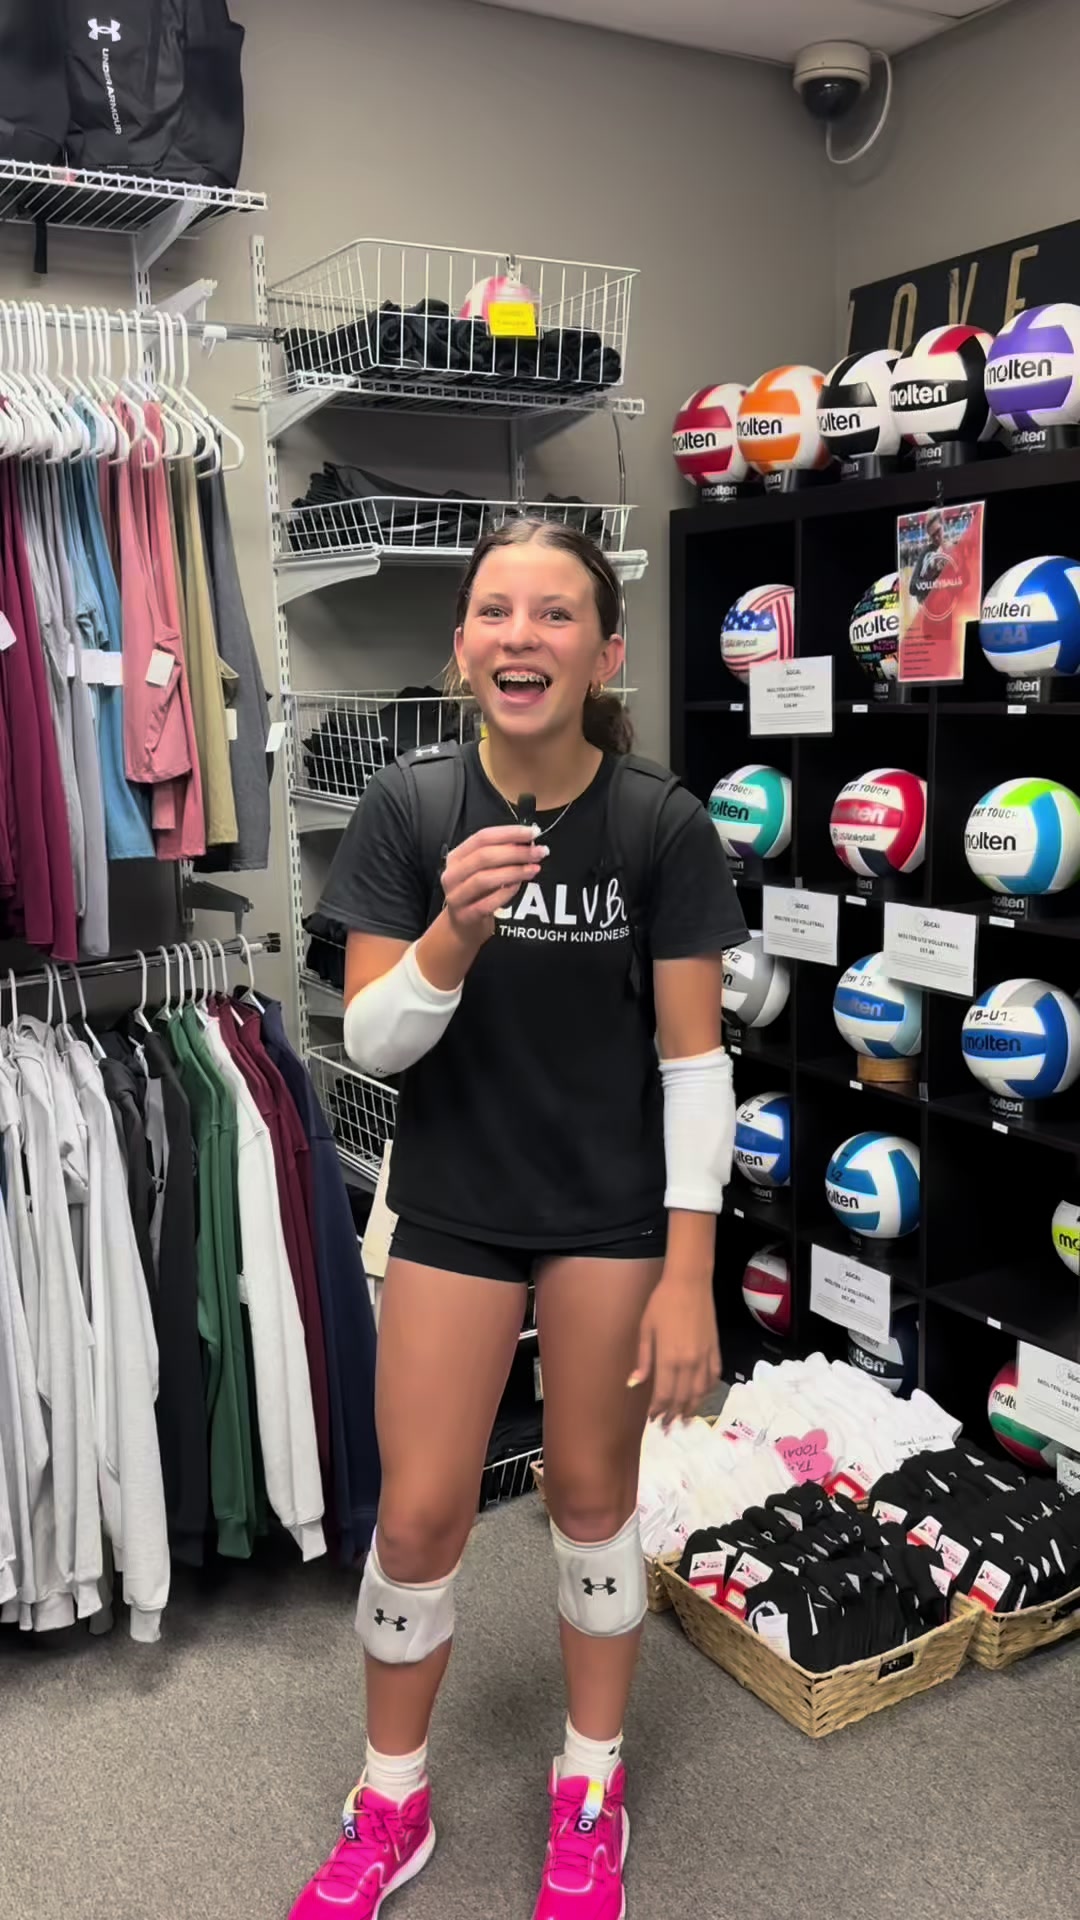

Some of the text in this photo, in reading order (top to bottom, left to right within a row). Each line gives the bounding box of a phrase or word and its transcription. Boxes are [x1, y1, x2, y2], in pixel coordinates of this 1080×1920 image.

[983, 603, 1031, 619] molten
[852, 615, 898, 642] molte
[494, 881, 577, 925] AL
[499, 925, 629, 943] THROUGH KINDNESS
[963, 1034, 1022, 1052] molten
[827, 1188, 860, 1209] olten
[853, 1349, 884, 1374] lten
[993, 1389, 1016, 1411] molt
